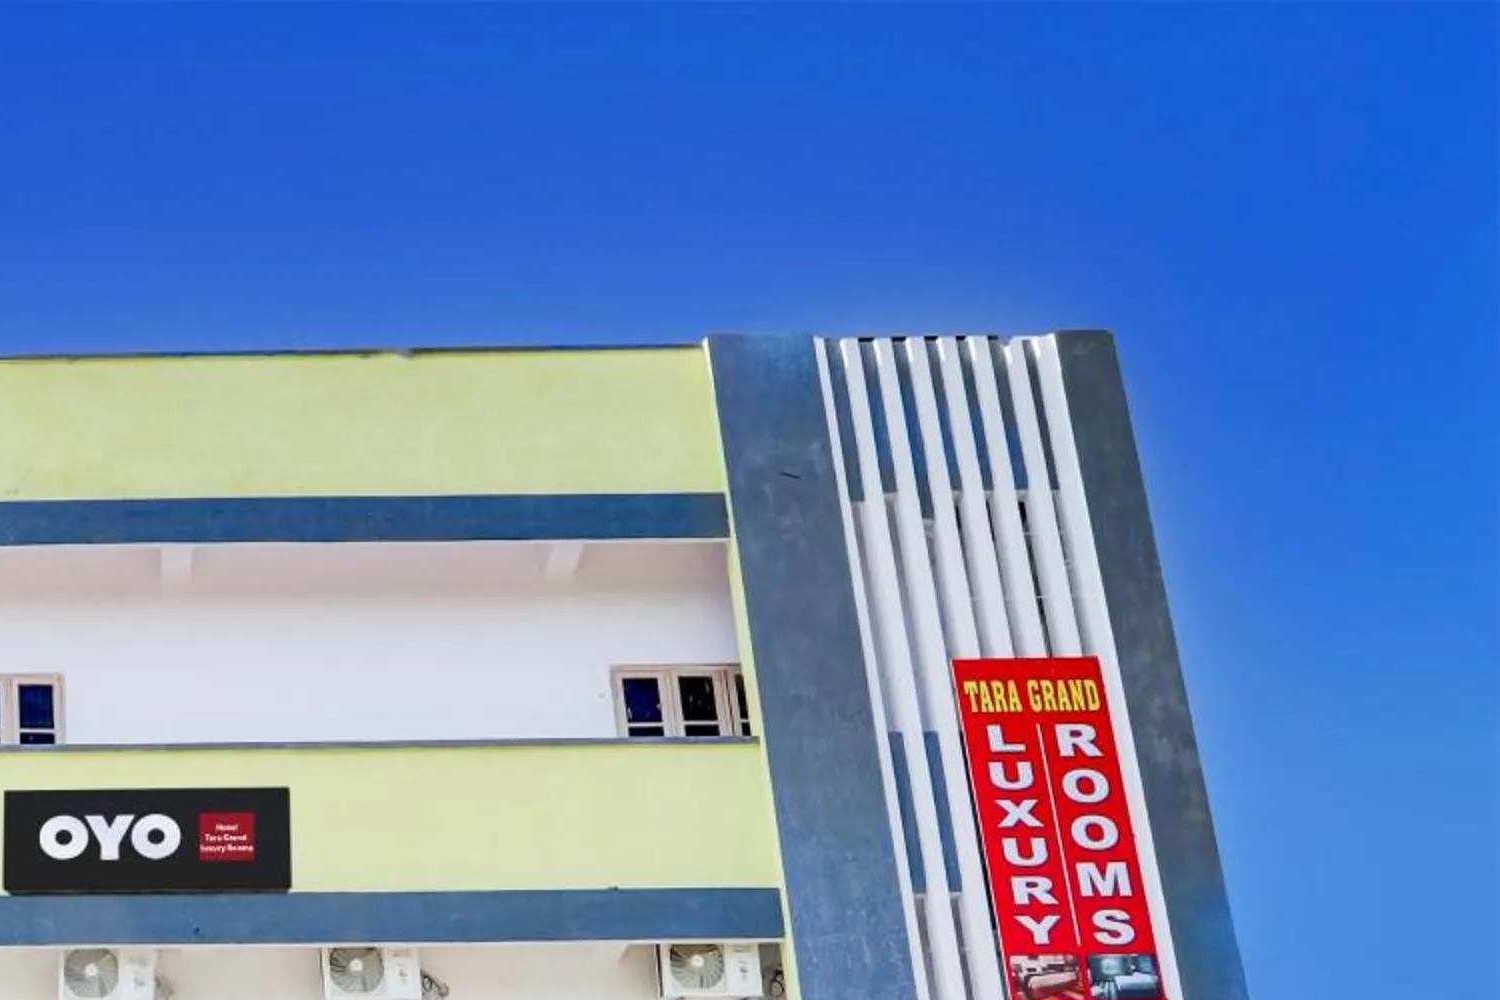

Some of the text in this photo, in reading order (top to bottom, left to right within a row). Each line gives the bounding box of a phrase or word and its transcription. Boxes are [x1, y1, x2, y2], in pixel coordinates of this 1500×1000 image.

[963, 678, 1102, 714] TARA GRAND
[39, 813, 182, 861] OYO
[986, 722, 1061, 946] LUXURY
[1054, 722, 1137, 948] ROOMS
